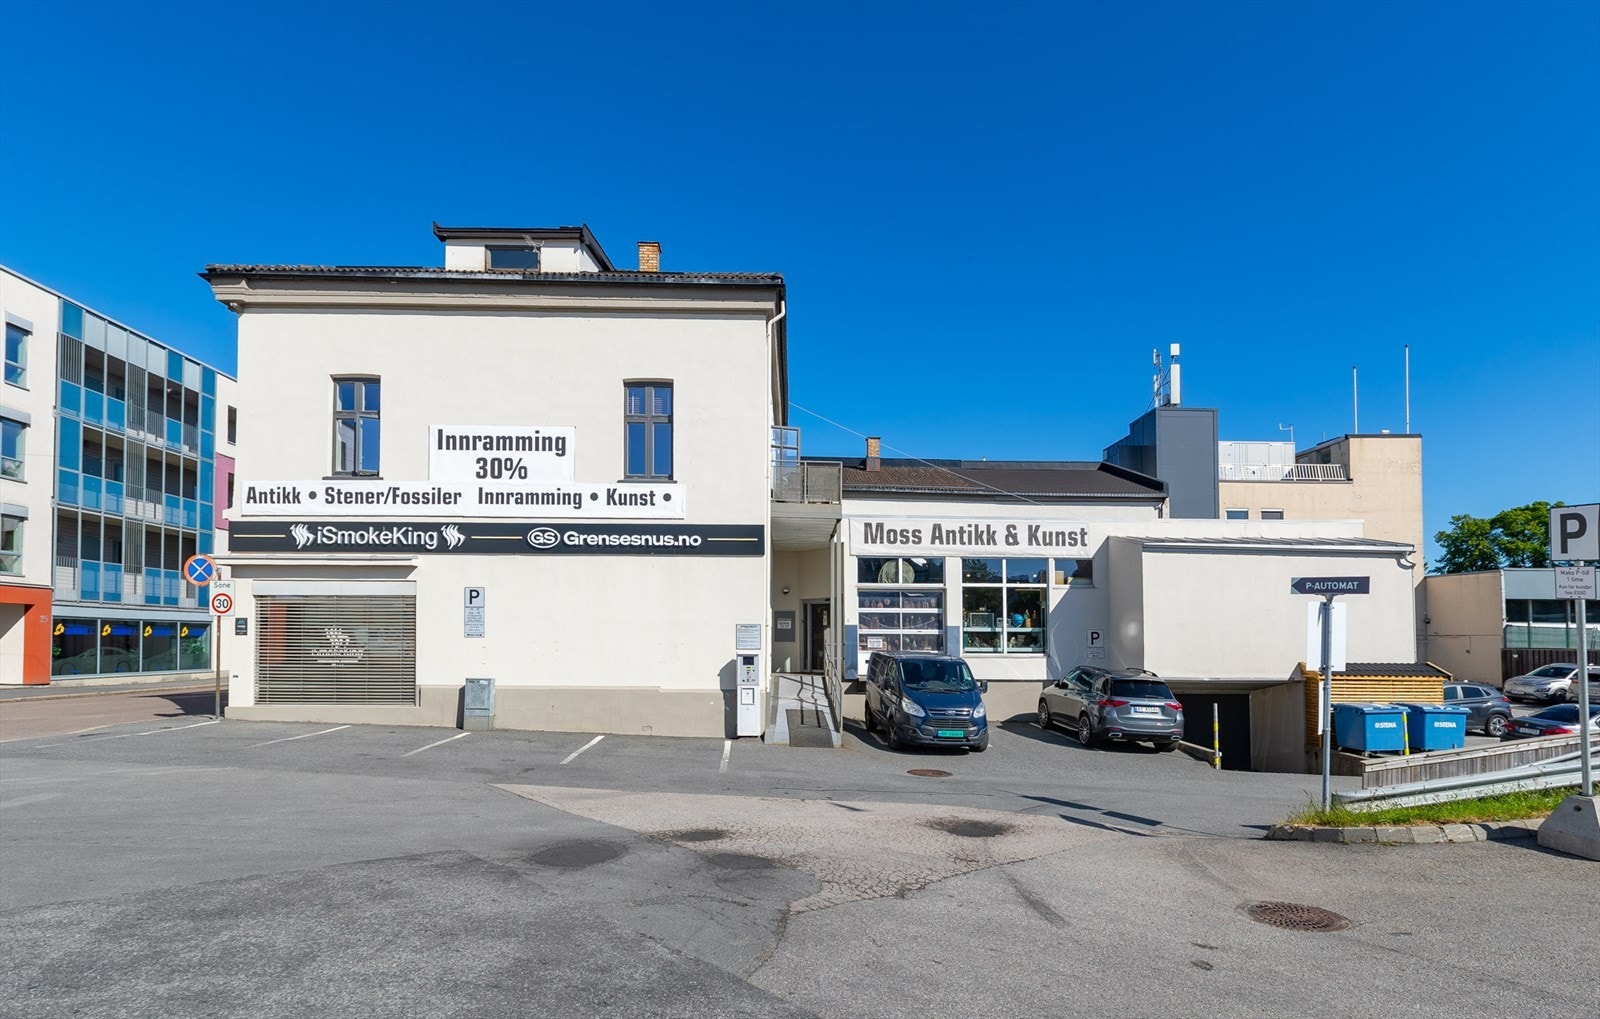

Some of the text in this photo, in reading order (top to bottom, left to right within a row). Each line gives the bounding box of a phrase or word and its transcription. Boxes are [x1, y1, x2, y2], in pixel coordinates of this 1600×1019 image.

[437, 428, 566, 457] Innramming
[475, 457, 528, 480] 30%
[246, 486, 655, 509] Antikk Stener/Fossiler Innramming Kunst
[317, 526, 438, 549] iSmokeKing
[532, 530, 701, 547] GS Grensesnus.no
[863, 522, 1088, 547] Moss Antikk & Kunst
[1560, 512, 1587, 554] P
[469, 589, 480, 605] P
[1305, 581, 1359, 590] P-AUTOMAT
[215, 598, 229, 609] 30
[1091, 631, 1100, 645] P
